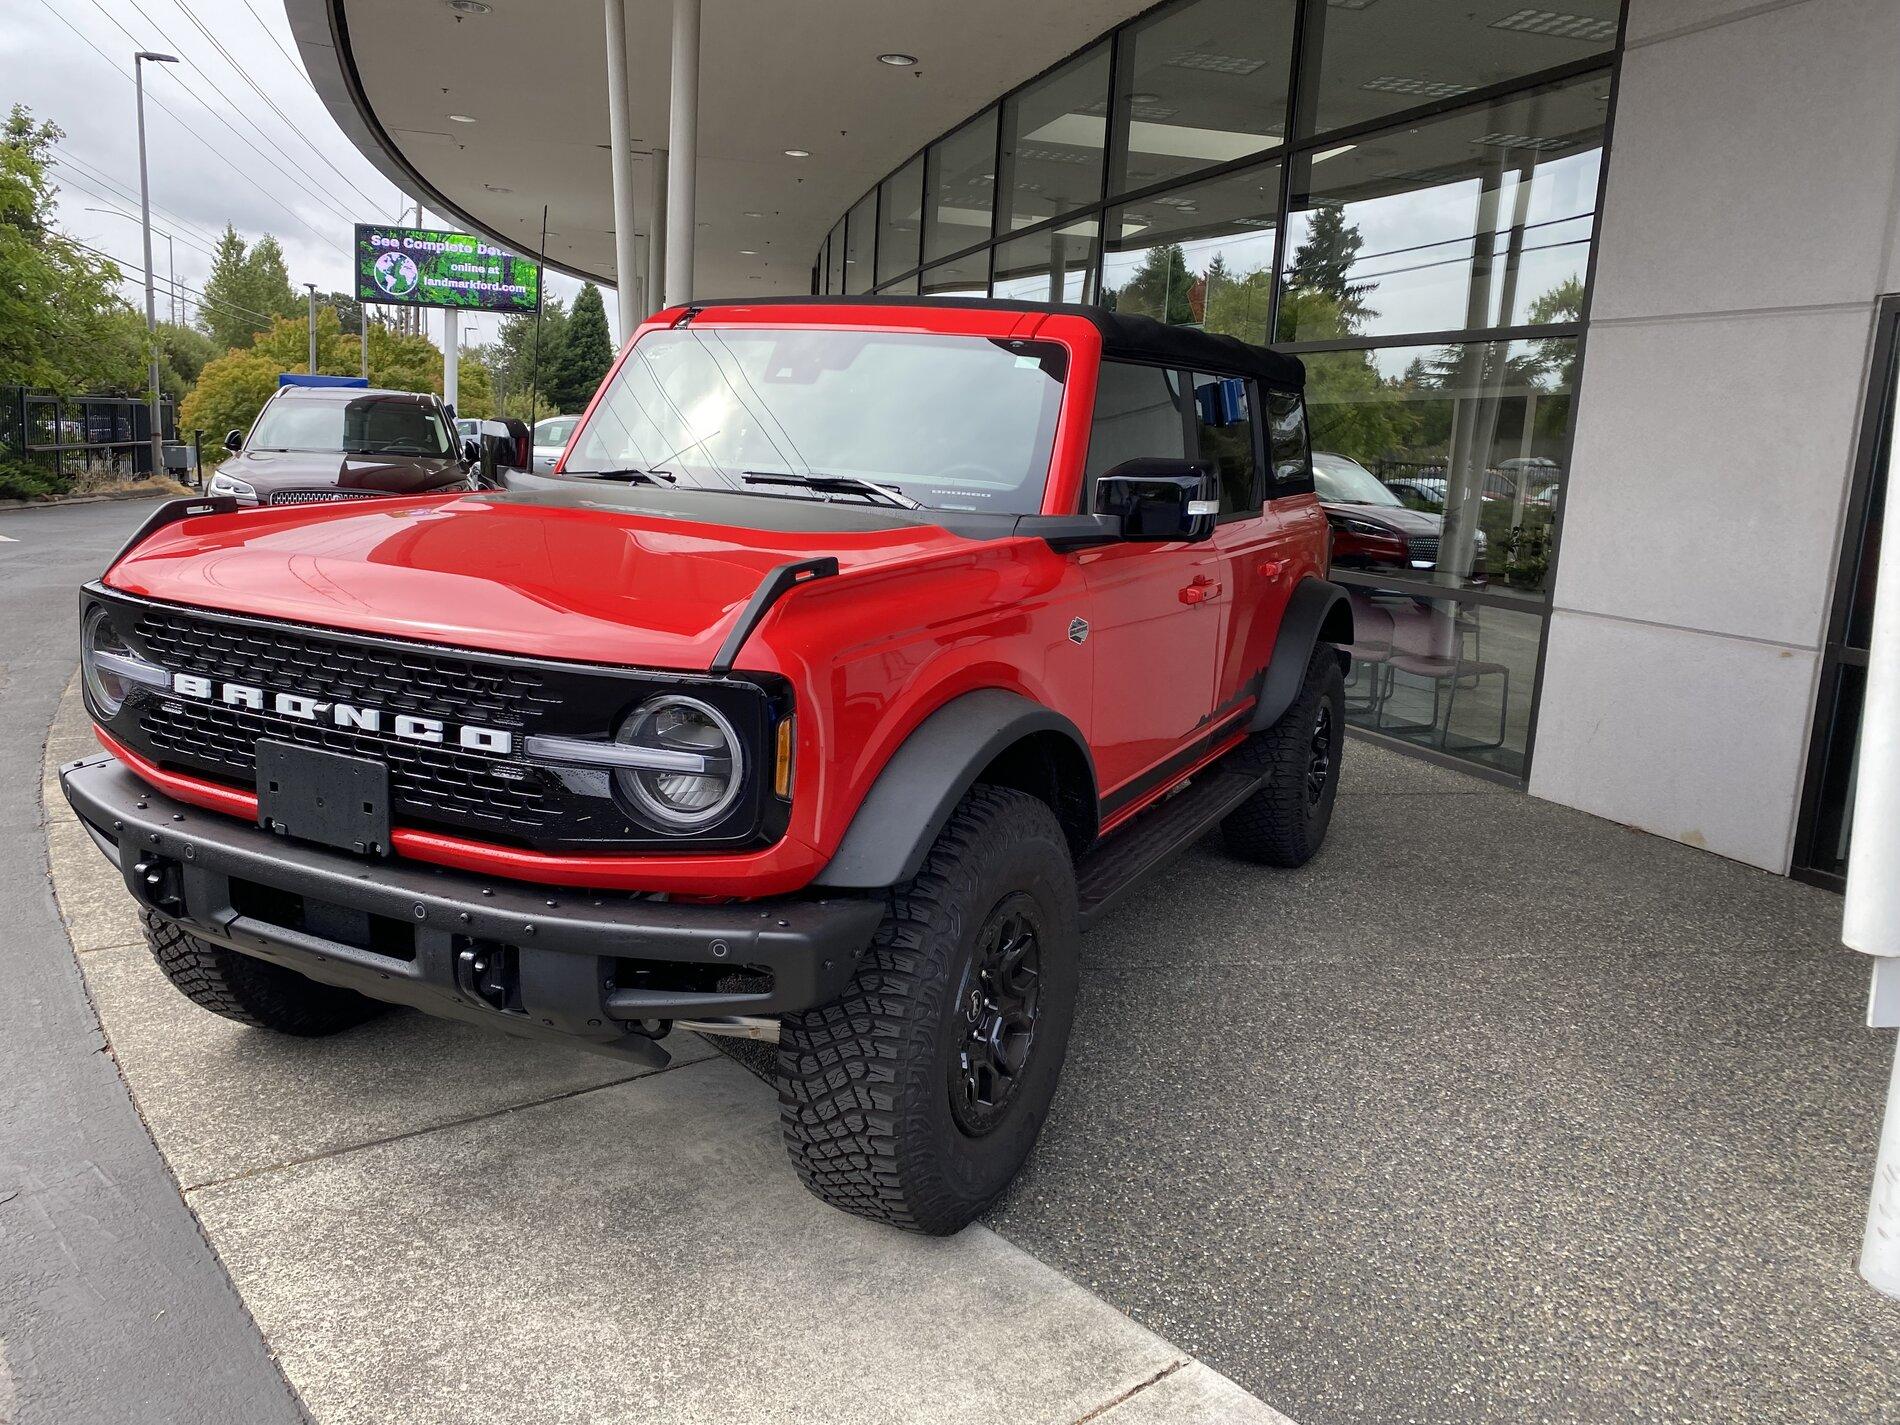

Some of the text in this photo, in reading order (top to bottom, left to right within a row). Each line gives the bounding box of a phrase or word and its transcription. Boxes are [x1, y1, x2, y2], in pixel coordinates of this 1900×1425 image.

[371, 235, 398, 248] See
[403, 237, 473, 253] Complete
[451, 263, 500, 275] online at
[424, 278, 526, 293] landmarkford.com
[173, 673, 512, 755] BRONCO
